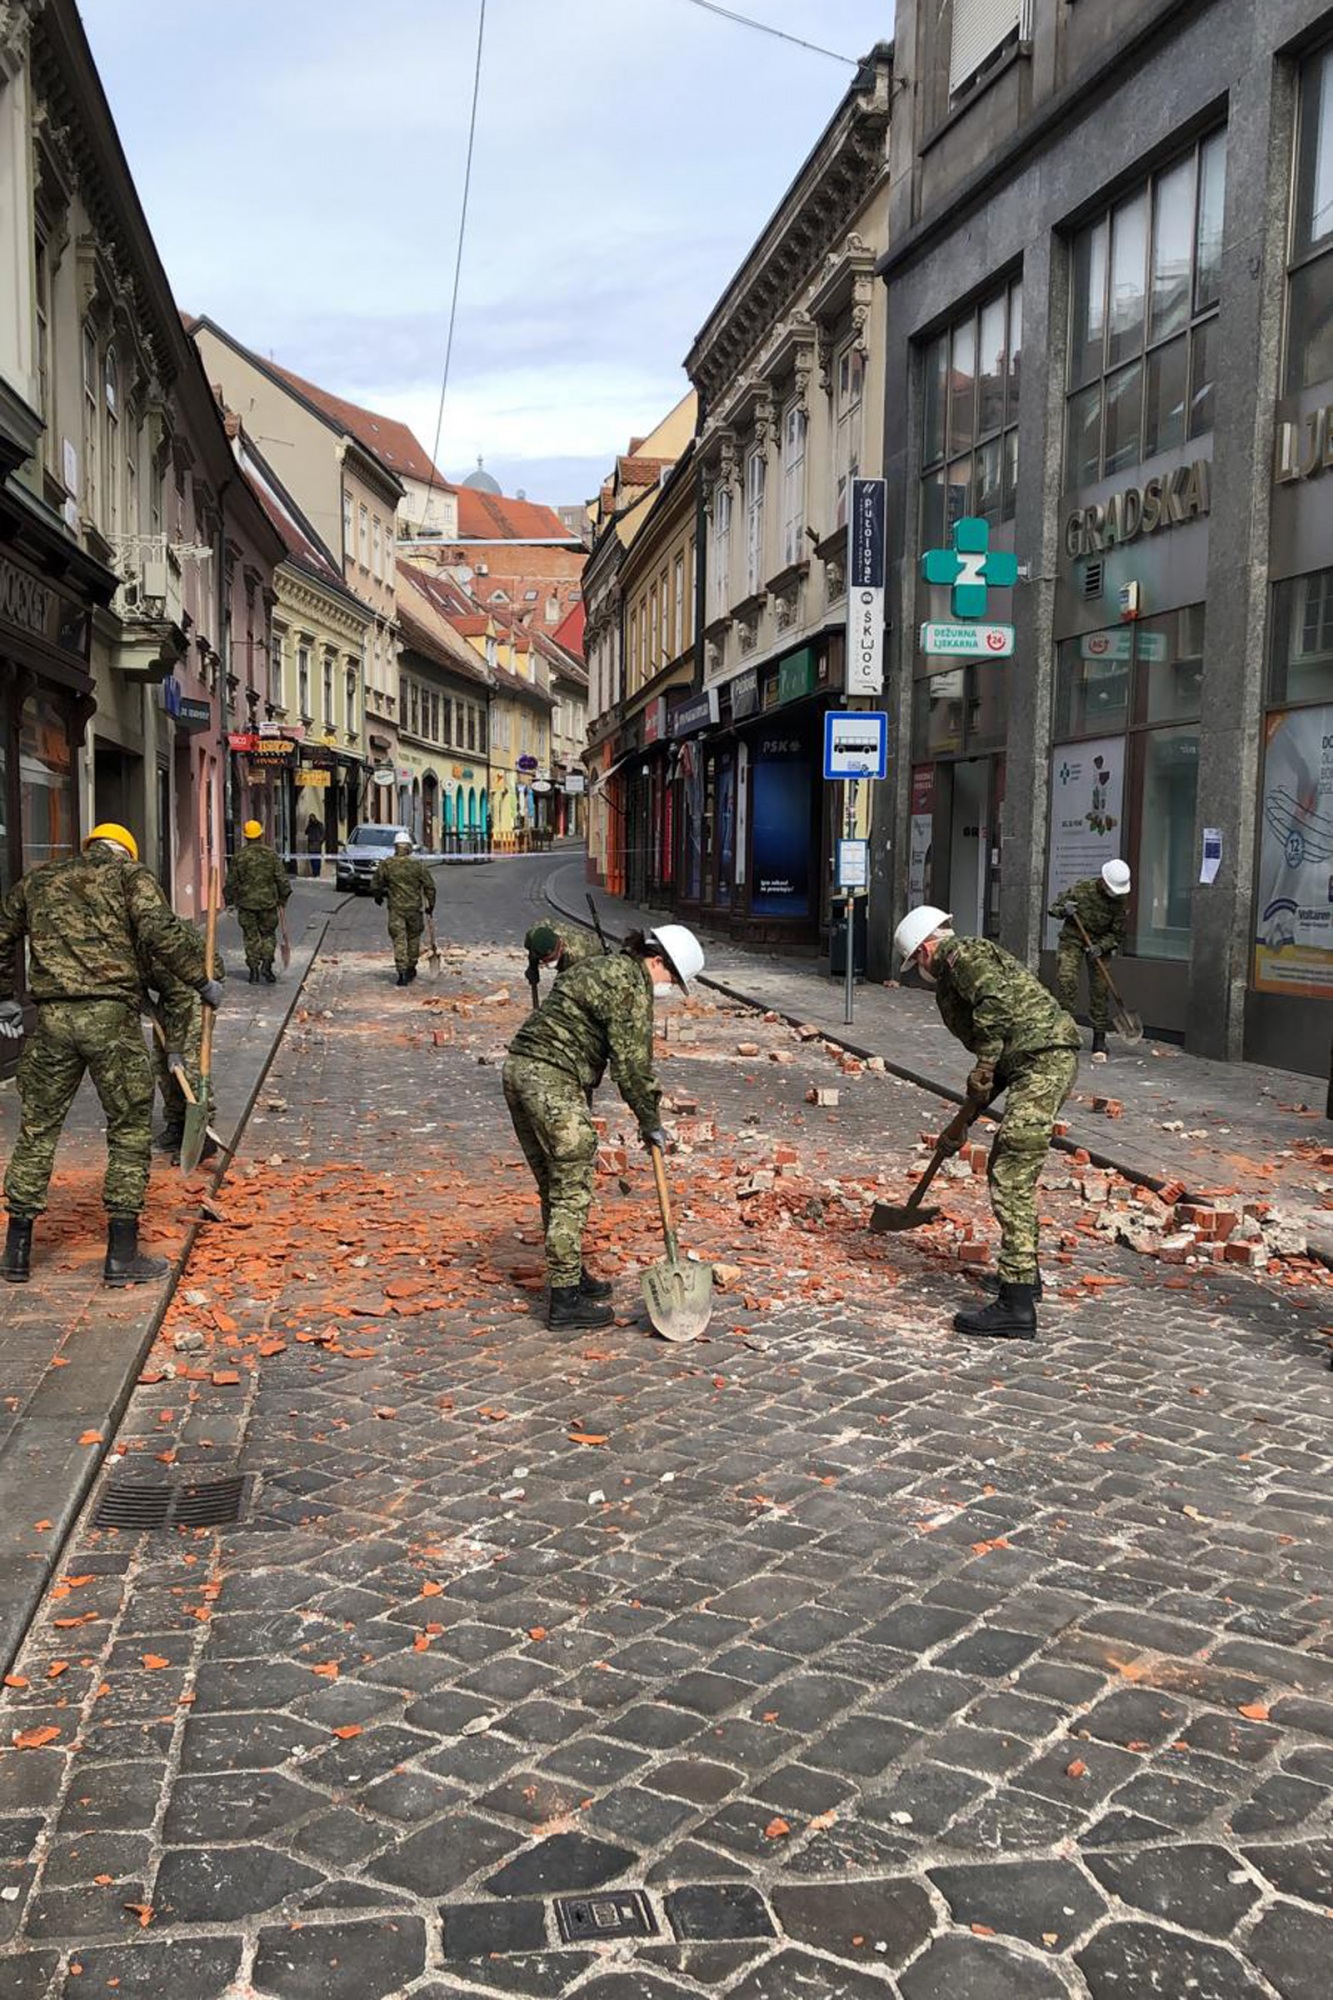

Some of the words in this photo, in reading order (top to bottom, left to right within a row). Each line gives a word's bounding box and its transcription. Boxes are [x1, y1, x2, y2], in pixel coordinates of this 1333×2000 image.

[1065, 459, 1211, 561] GRADSKA
[864, 498, 872, 583] putolovac
[934, 627, 977, 638] DEŽURNA
[934, 638, 978, 649] LJEKARNA
[763, 740, 788, 753] PSK
[1290, 838, 1300, 852] 12
[1299, 908, 1331, 921] Voltaren
